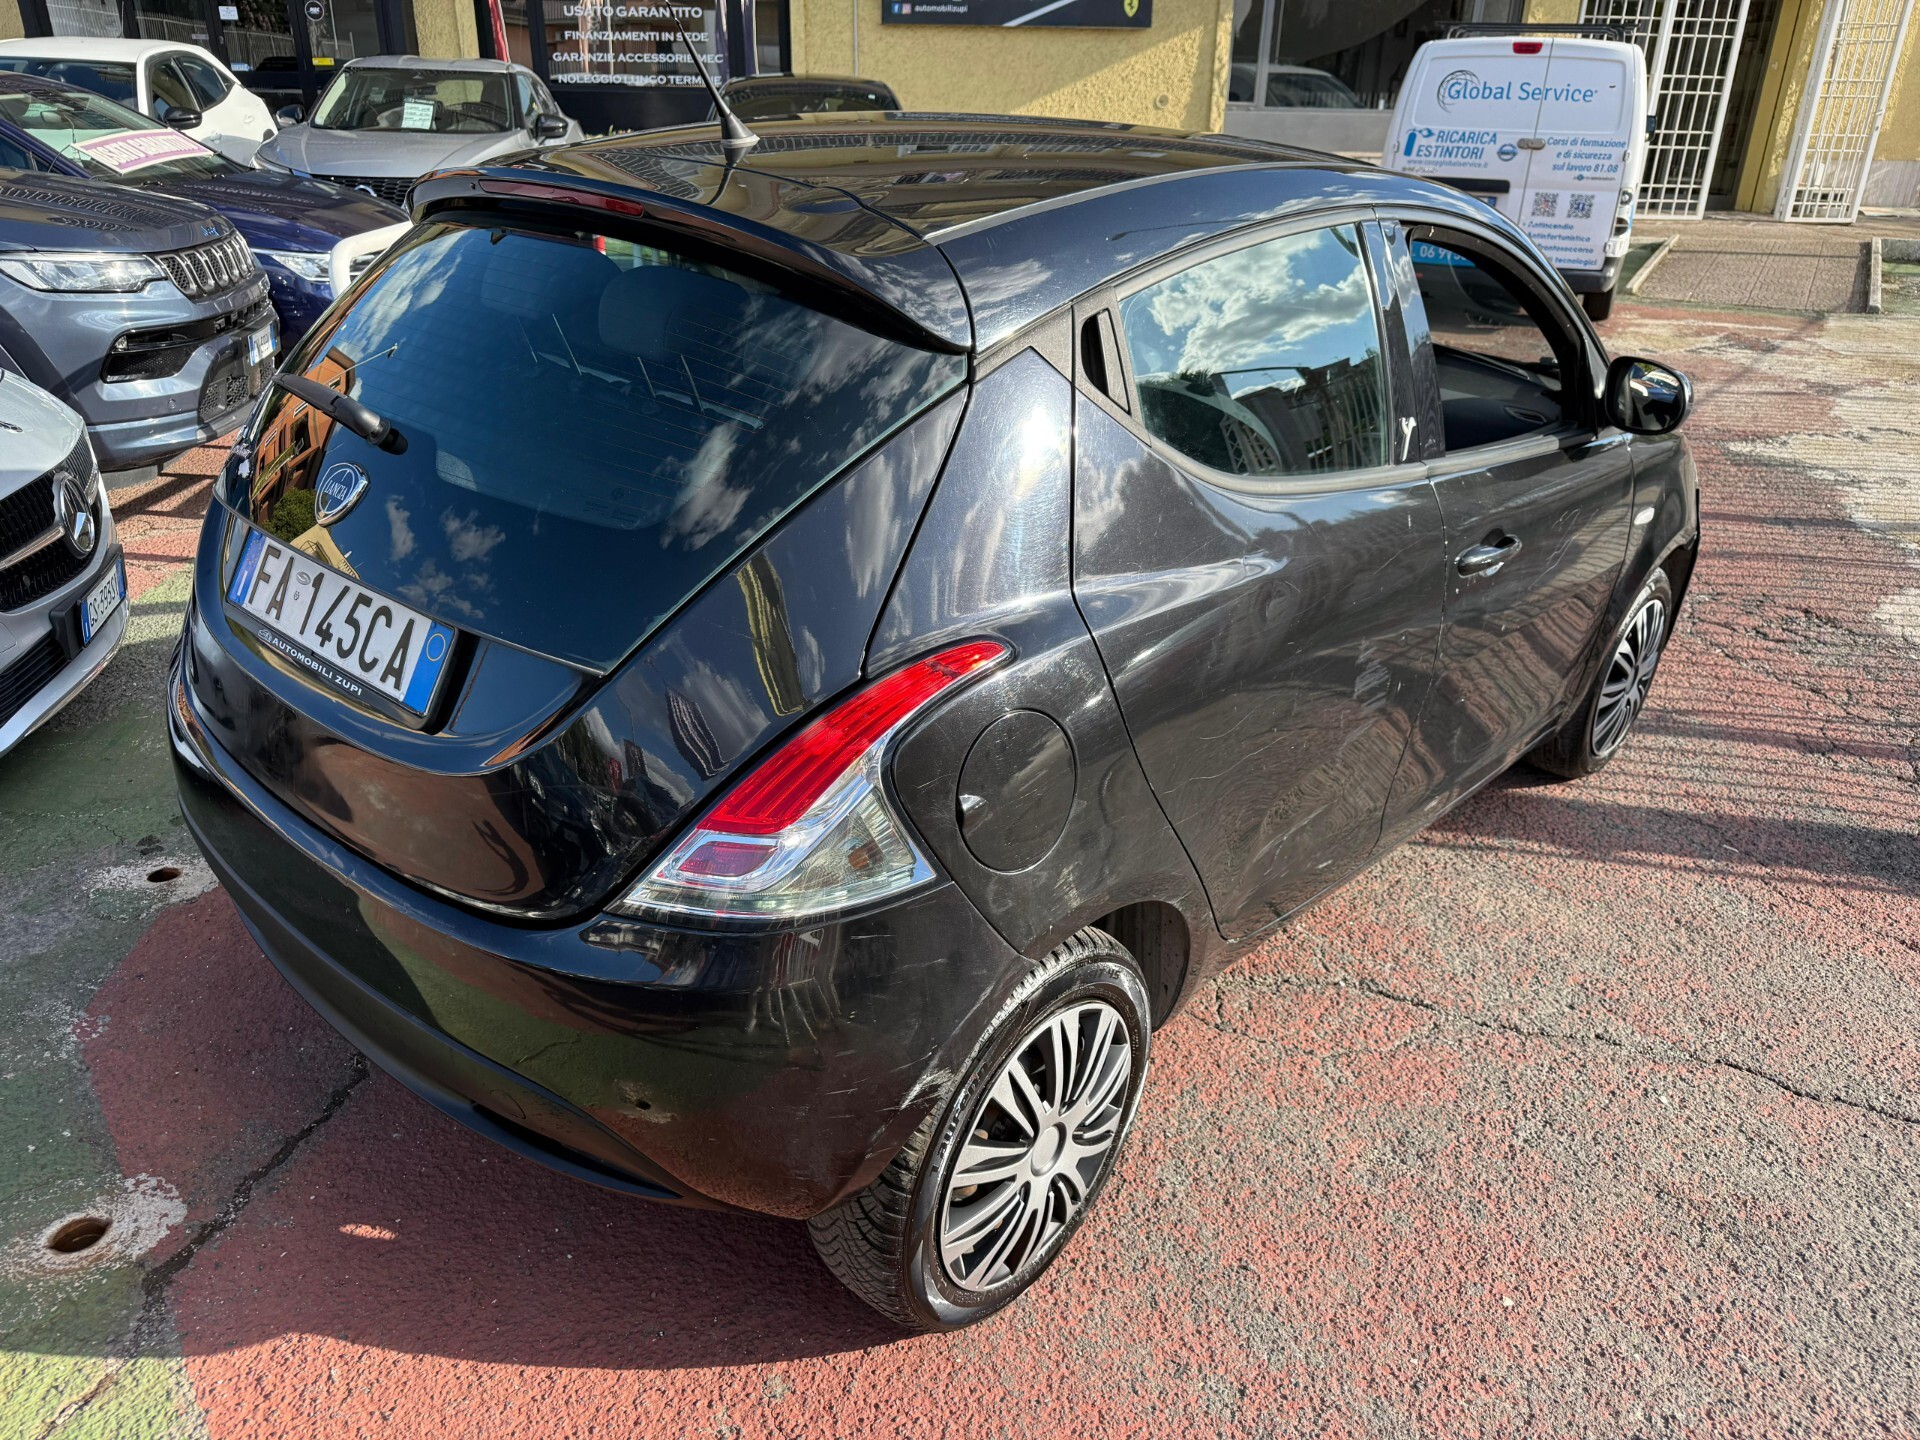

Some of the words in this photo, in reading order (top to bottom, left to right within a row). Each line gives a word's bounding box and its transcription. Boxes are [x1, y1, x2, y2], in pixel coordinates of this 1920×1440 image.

[563, 5, 613, 17] USATO
[616, 6, 703, 18] GARANTITO
[564, 30, 660, 41] FINANZIAMENTI
[662, 32, 675, 42] IN
[552, 52, 615, 63] GARANZIE
[558, 74, 621, 84] NOLEGGIO
[623, 75, 667, 85] LUNGO
[1447, 81, 1512, 101] Global
[1518, 82, 1595, 103] Service
[1435, 130, 1497, 145] RICARICA
[1547, 137, 1569, 146] Corsi
[1570, 137, 1580, 146] di
[1580, 137, 1627, 148] formazione
[1415, 145, 1485, 160] ESTINTORI
[1563, 150, 1572, 159] di
[1573, 151, 1612, 160] sicurezza
[1552, 162, 1565, 171] sul
[1566, 163, 1592, 172] lavoro
[1593, 164, 1619, 173] 81.08
[1419, 245, 1436, 258] 06
[323, 479, 348, 501] LANCIA
[272, 637, 333, 679] AUTOMOBILI
[335, 675, 363, 696] ZUPI
